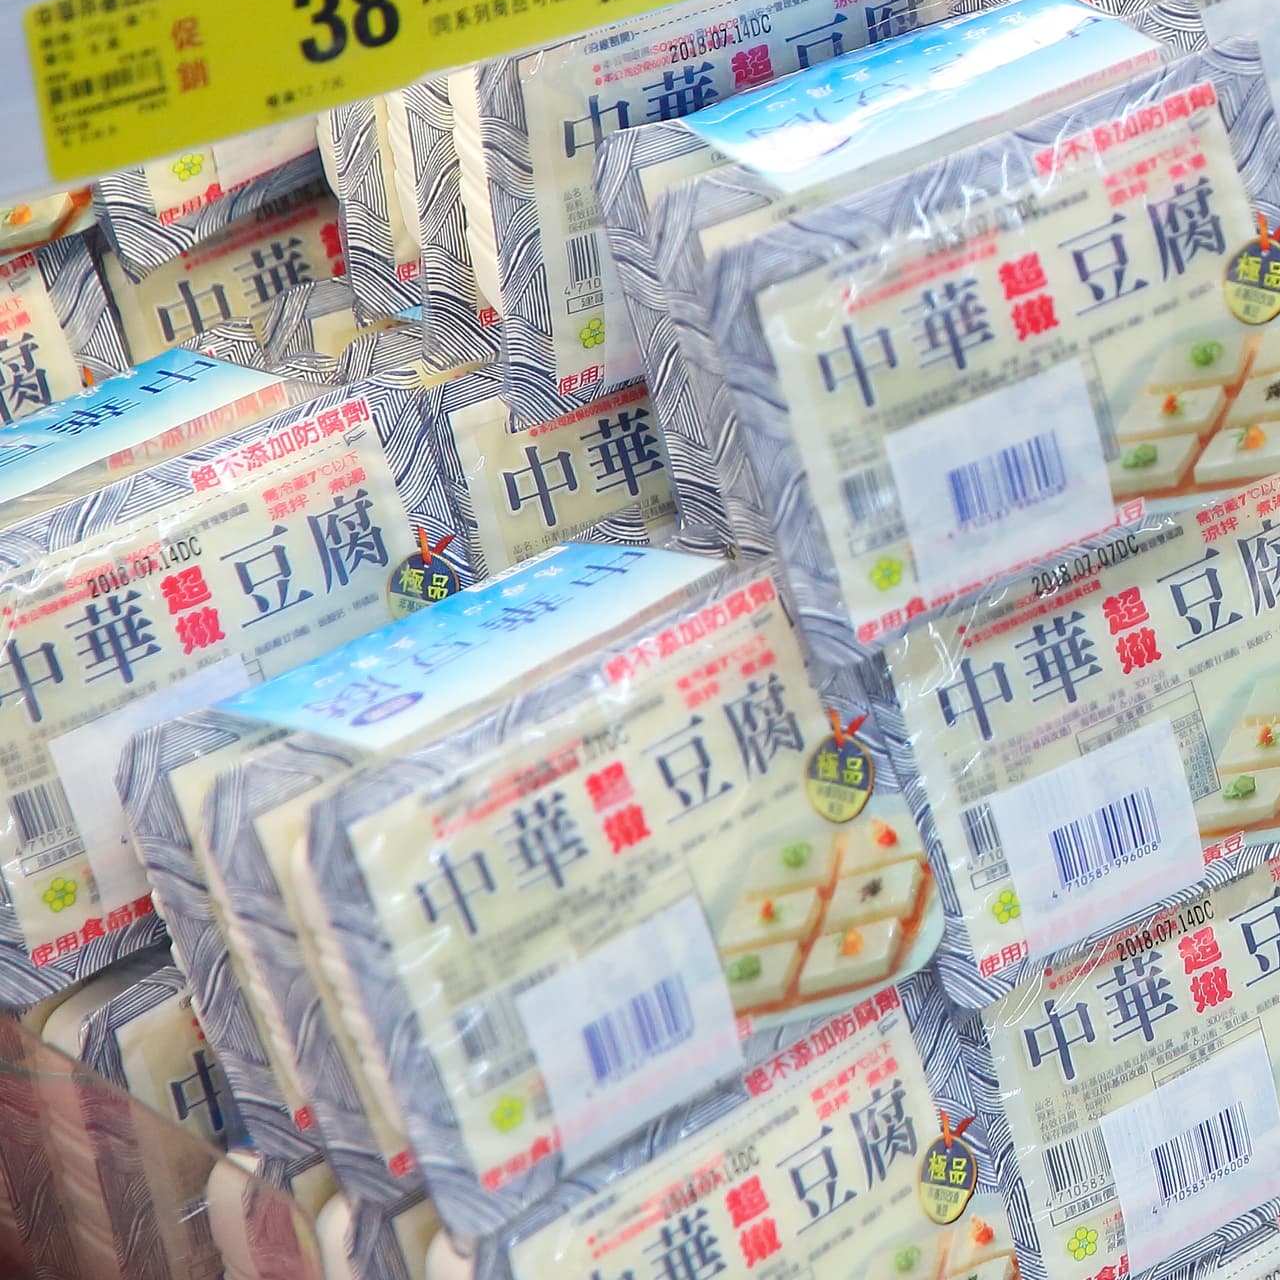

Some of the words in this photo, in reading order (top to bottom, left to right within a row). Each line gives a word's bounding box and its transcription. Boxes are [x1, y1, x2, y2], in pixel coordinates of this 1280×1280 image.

[171, 17, 209, 94] 促銷
[670, 14, 772, 64] 2018.07.14DC
[816, 277, 995, 408] 中華
[998, 251, 1059, 342] 超嫩
[1057, 176, 1227, 317] 豆腐
[190, 397, 370, 493] 絕不添加防腐劑
[503, 408, 665, 527] 中華
[87, 536, 202, 599] 2018.07.14DC
[398, 565, 450, 601] 極品
[1031, 534, 1139, 596] 2018.07.07DC
[0, 591, 163, 723] 中華
[160, 567, 226, 657] 超嫩
[219, 489, 391, 629] 豆腐
[605, 578, 778, 684] 絕不添加防腐劑
[937, 611, 1101, 740] 中華
[1102, 585, 1162, 673] 超嫩
[417, 792, 590, 935] 中華
[586, 762, 651, 854] 超嫩
[639, 672, 808, 823] 豆腐
[816, 748, 866, 786] 極品
[1065, 866, 1110, 893] 710583
[1113, 840, 1159, 869] 996008
[1117, 902, 1214, 958] 2018.07.14DC
[744, 984, 901, 1098] 絕不添加防腐劑
[1023, 951, 1178, 1081] 中華
[1178, 926, 1233, 1013] 超嫩
[724, 1175, 783, 1269] 超嫩
[776, 1078, 918, 1236] 豆腐
[928, 1150, 967, 1186] 極品
[1053, 1175, 1107, 1202] 710583
[1163, 1180, 1206, 1208] 710583
[1208, 1153, 1250, 1182] 996008
